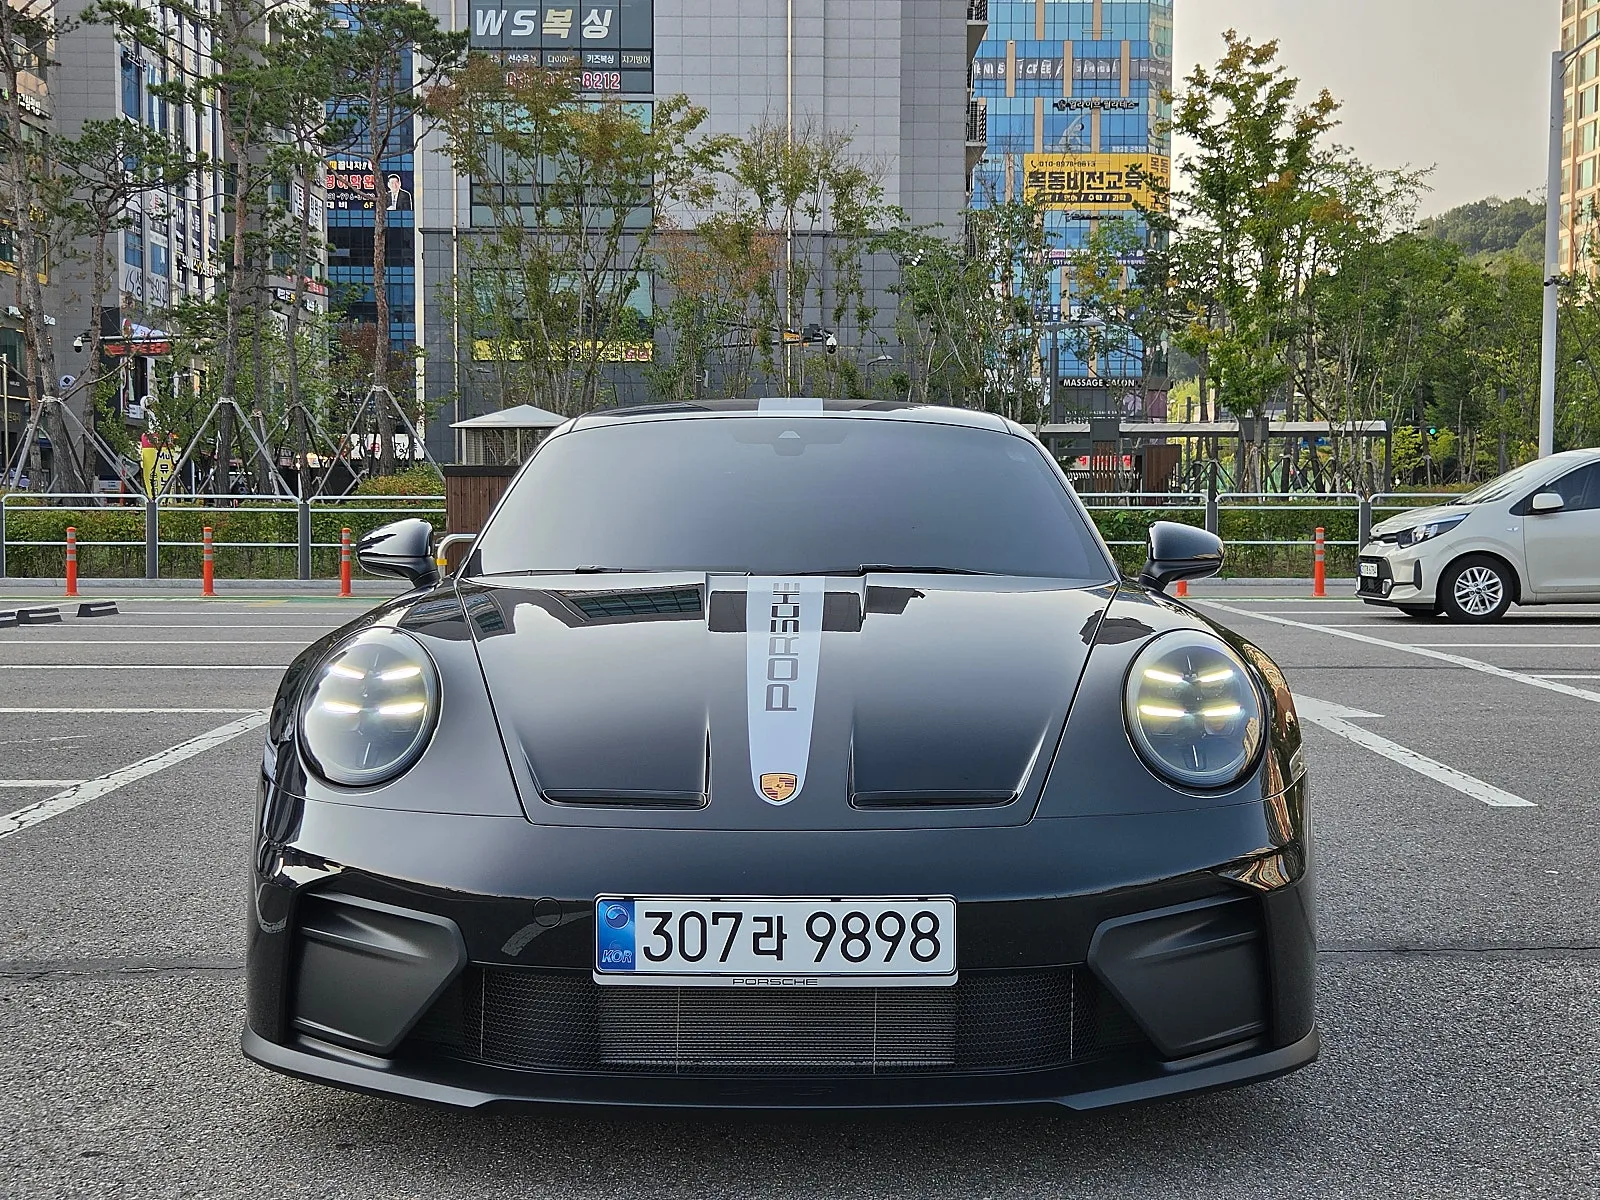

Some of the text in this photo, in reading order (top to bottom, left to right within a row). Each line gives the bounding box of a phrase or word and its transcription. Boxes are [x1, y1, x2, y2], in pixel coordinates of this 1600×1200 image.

[586, 54, 614, 64] 키즈복싱
[621, 54, 651, 64] 자기방어
[326, 174, 375, 190] 영어학원
[1028, 170, 1143, 191] 목동비전교육
[1063, 378, 1103, 387] MASSAGE
[765, 582, 801, 712] PORSCHE
[642, 910, 941, 963] 307라 9898
[601, 950, 632, 963] KOR
[732, 978, 819, 986] PORSCHE
